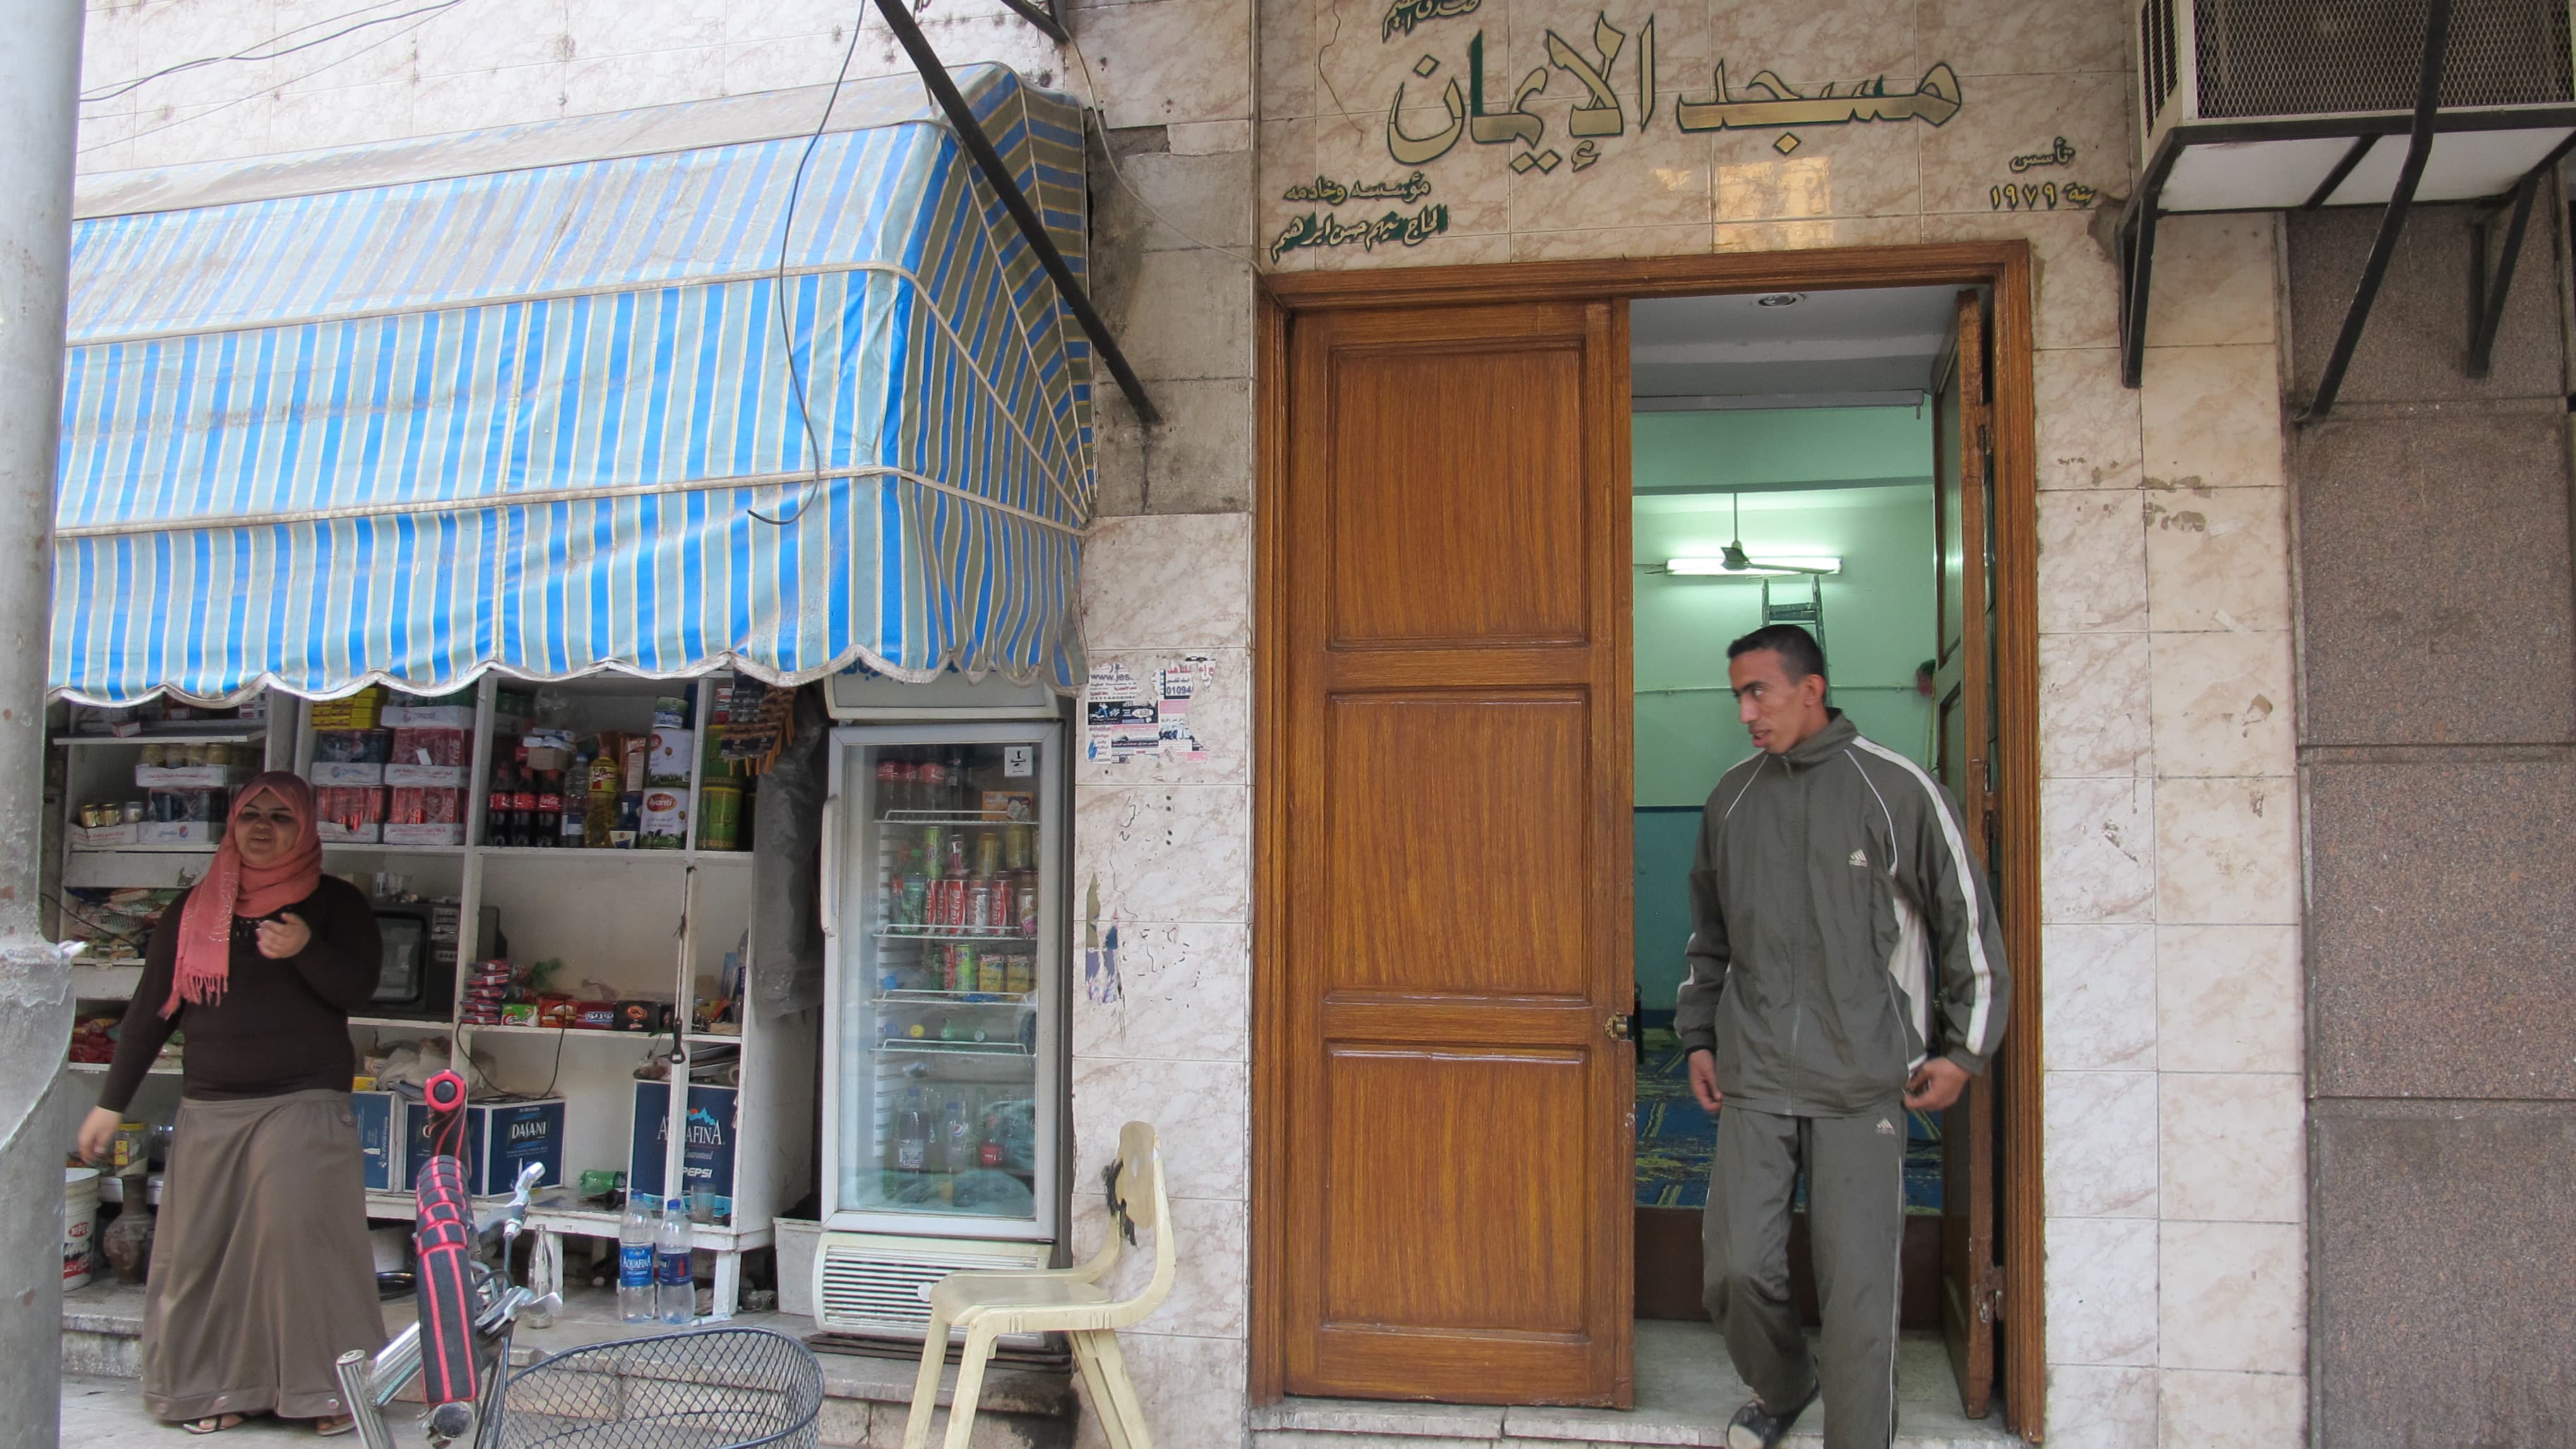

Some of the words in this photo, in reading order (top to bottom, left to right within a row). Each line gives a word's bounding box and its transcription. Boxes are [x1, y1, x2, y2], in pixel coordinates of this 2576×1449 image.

[1676, 58, 1962, 156] مسجد
[1990, 181, 2057, 210] ١٩٧٩
[511, 1121, 547, 1139] DASANI
[657, 1116, 722, 1145] AAFINA
[683, 1167, 712, 1179] PEPSI
